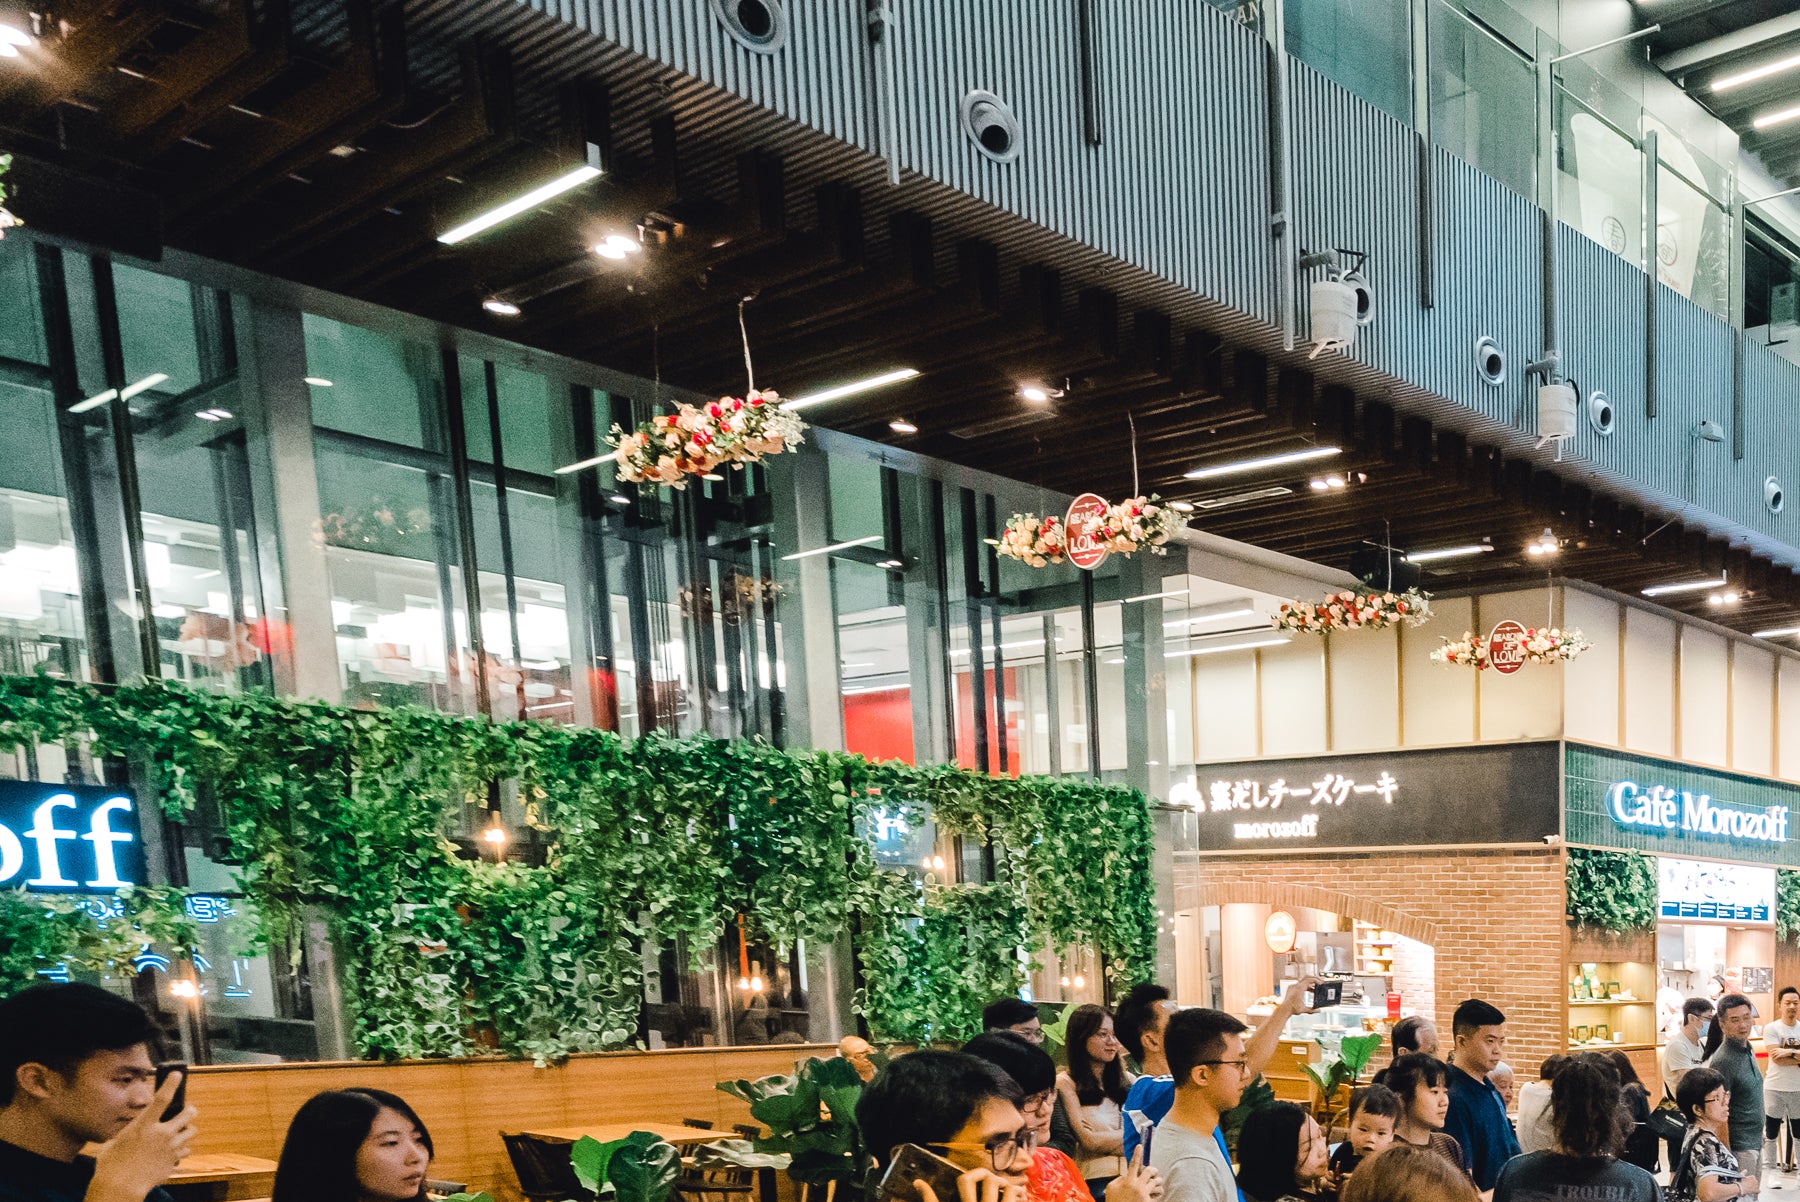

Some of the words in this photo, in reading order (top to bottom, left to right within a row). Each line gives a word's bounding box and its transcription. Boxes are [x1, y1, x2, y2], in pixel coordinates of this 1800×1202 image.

[1234, 814, 1319, 839] morozoff
[1614, 781, 1677, 829] Café
[1682, 792, 1789, 842] Morozoff
